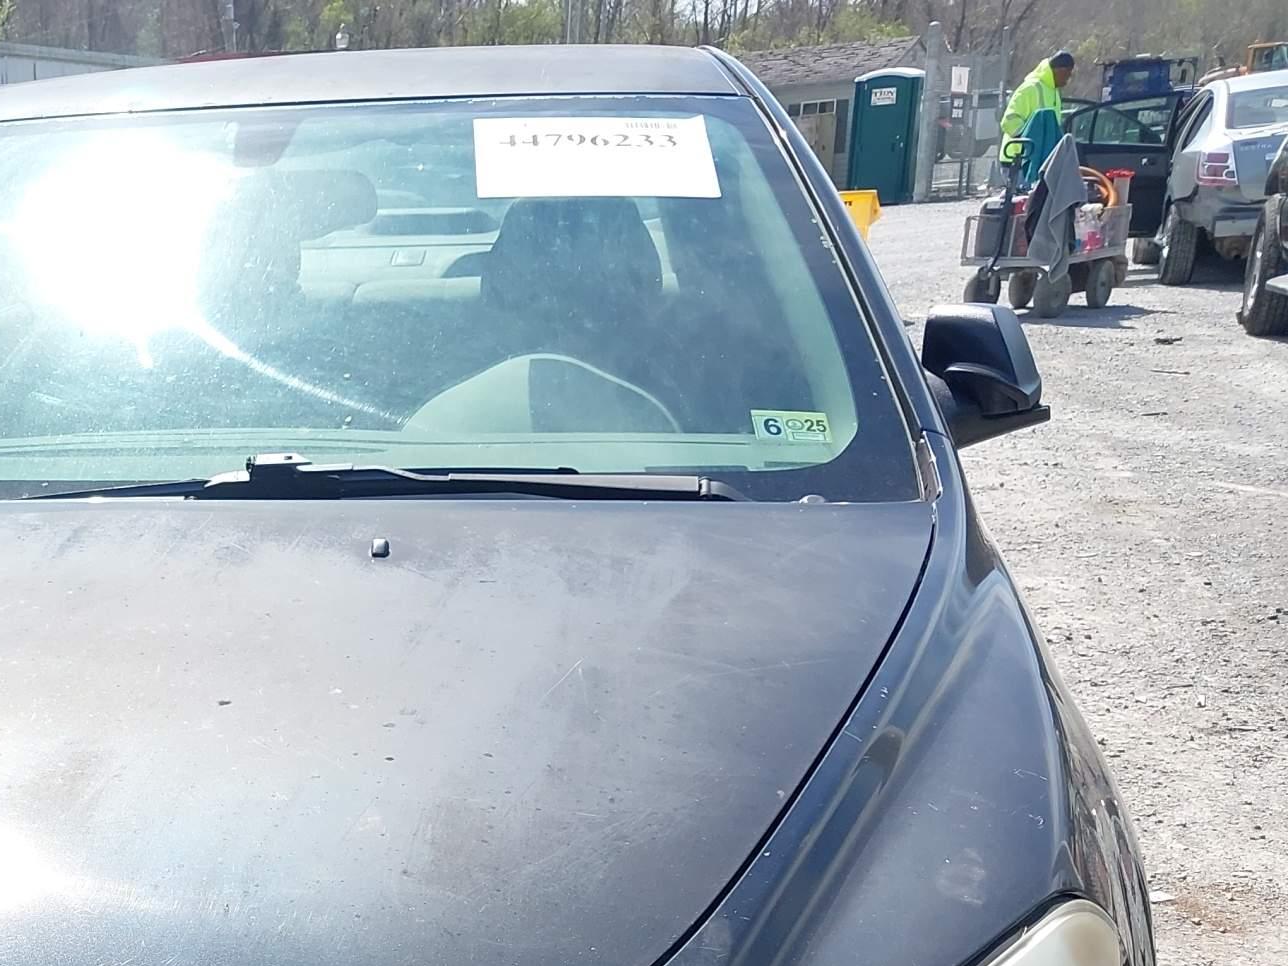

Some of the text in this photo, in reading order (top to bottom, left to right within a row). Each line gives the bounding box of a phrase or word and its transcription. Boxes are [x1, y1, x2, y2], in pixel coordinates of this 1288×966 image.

[499, 133, 678, 148] 44796233
[763, 418, 827, 436] 6 25
